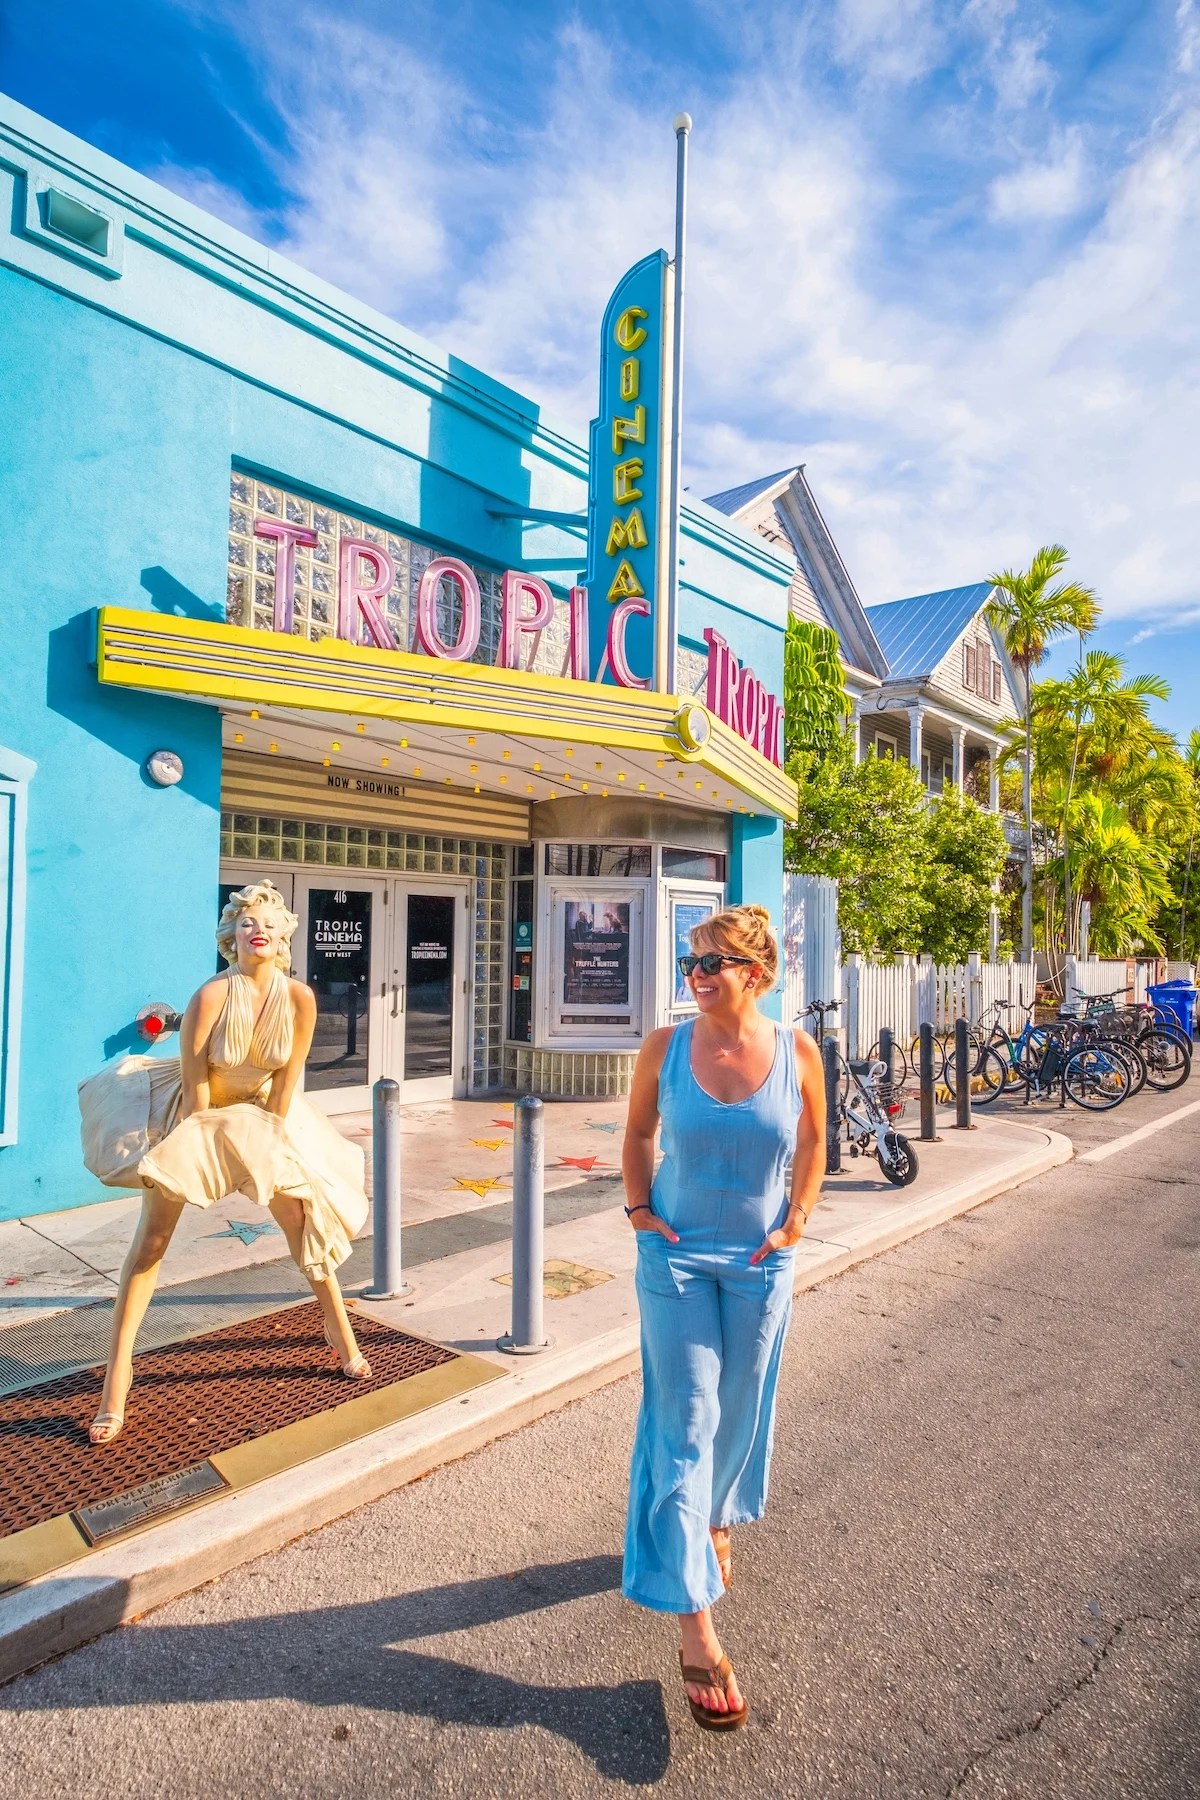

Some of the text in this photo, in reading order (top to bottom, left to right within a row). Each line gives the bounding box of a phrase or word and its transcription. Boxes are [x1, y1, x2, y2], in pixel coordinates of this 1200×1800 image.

[605, 304, 648, 604] CINEMA
[253, 516, 652, 690] TROPIC
[703, 627, 786, 771] TROPIC
[327, 775, 405, 797] NOW SHOWING!
[333, 890, 347, 904] 416
[314, 931, 363, 943] CINEMA
[315, 920, 362, 932] TROPIC
[88, 1487, 146, 1514] FOREVER
[149, 1465, 203, 1489] MARILYN
